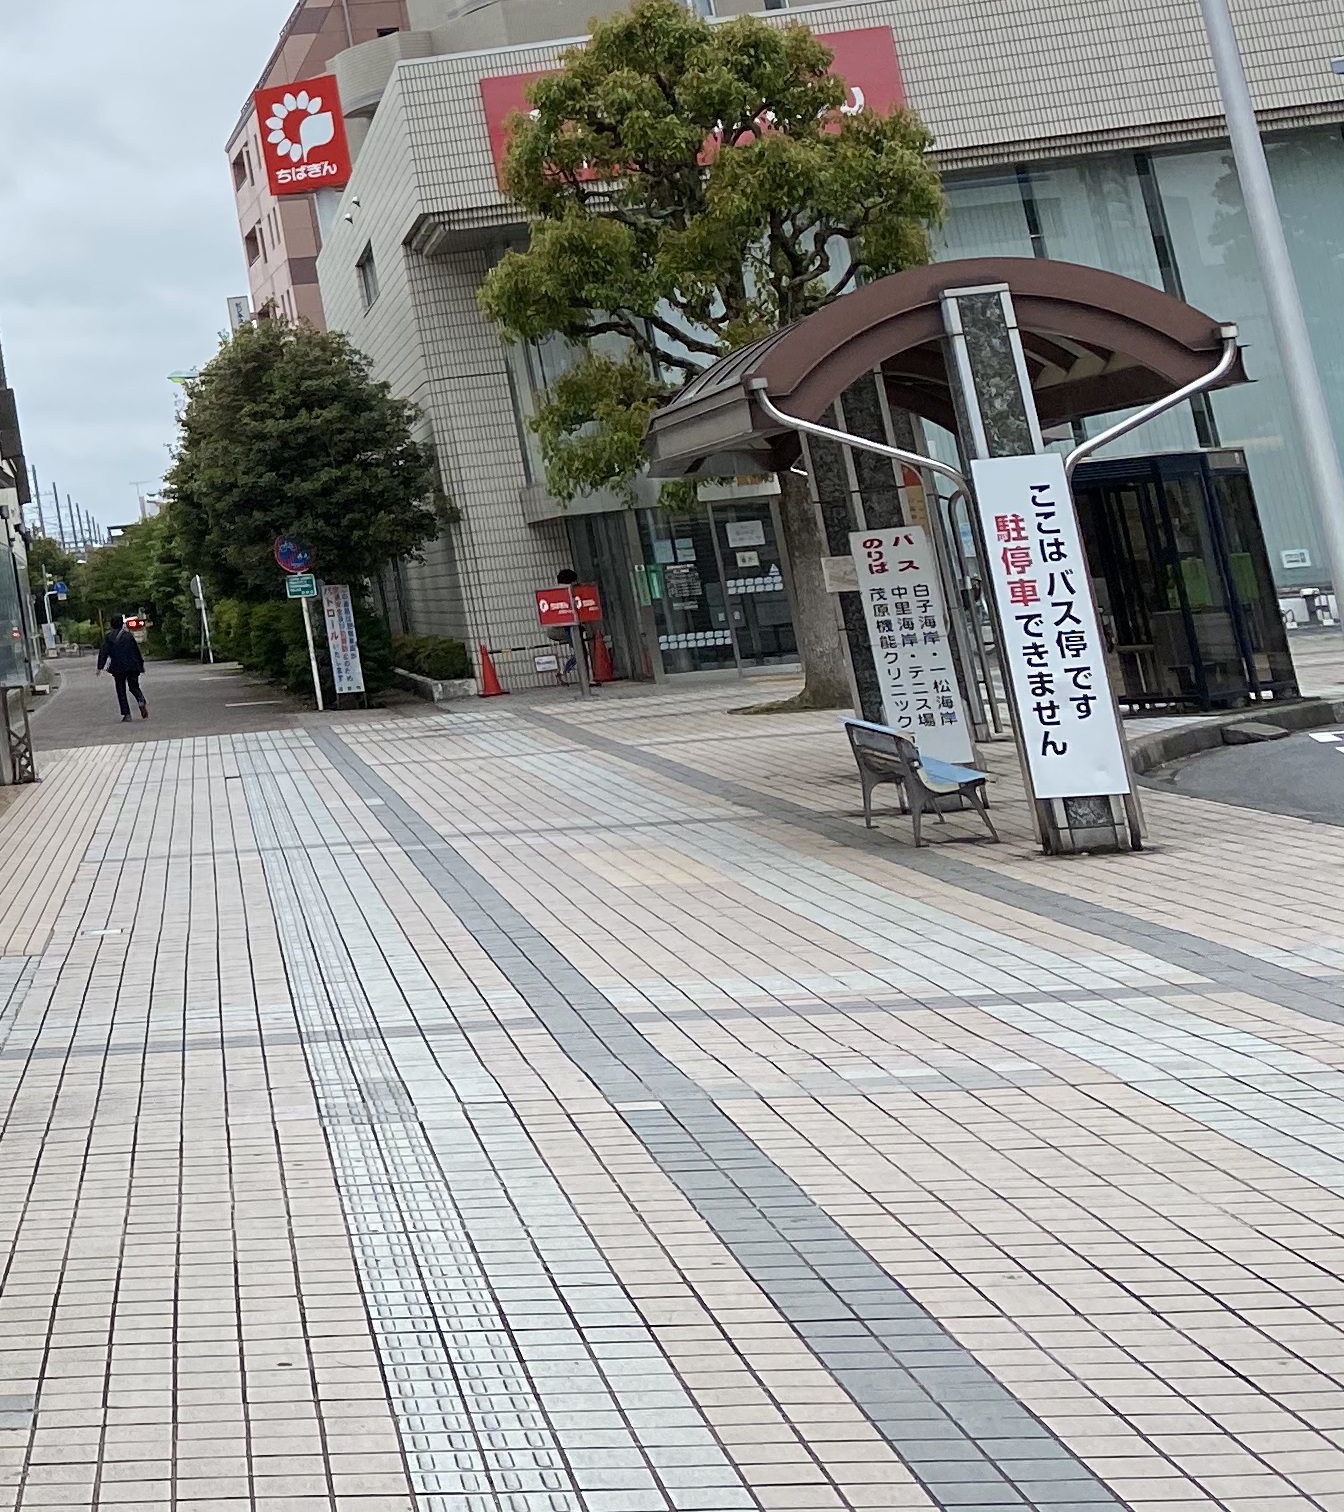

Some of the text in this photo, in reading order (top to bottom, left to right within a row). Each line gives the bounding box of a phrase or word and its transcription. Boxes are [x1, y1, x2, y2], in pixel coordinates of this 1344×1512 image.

[276, 160, 337, 184] ちばぎん
[893, 533, 920, 572] バス
[1029, 484, 1097, 720] ここはバス停です
[869, 587, 919, 756] 茂原機能クリニック
[891, 584, 936, 727] 中里海岸・テニス場
[913, 583, 958, 727] 白子海岸・一松海岸
[994, 513, 1068, 757] 駐停車できません
